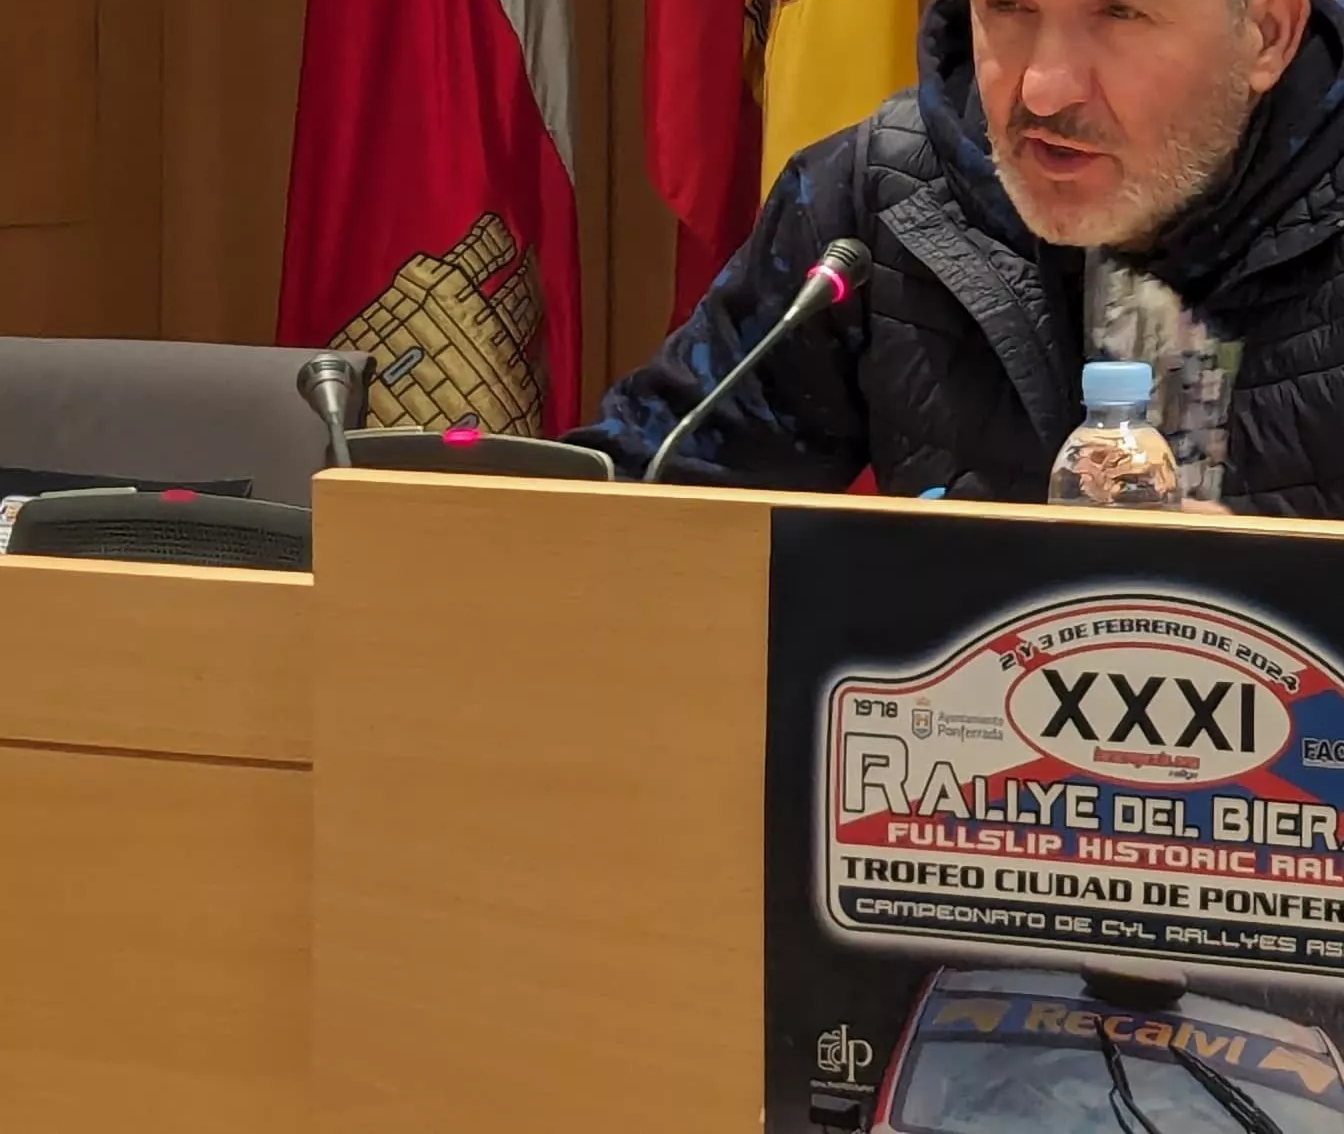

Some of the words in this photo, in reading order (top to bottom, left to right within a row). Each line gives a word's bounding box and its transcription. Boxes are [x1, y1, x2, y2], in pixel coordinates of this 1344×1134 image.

[1059, 624, 1089, 644] DE
[1092, 617, 1197, 641] FEBRERO
[1202, 630, 1232, 652] DE
[1235, 644, 1300, 692] 2024
[853, 698, 899, 718] 1978
[1040, 667, 1256, 754] XXXI
[842, 730, 1101, 831] RALLYE
[1112, 792, 1201, 841] DEL
[886, 821, 1063, 857] FULLSLIP
[1077, 835, 1258, 874] HISTORIC
[840, 855, 985, 889] TROFEO
[994, 868, 1133, 904] CIUDAD
[1142, 880, 1191, 909] DE
[855, 896, 1046, 930] CAMPEONATO
[1054, 914, 1093, 934] DE
[1101, 918, 1157, 941] CYL
[1164, 925, 1298, 954] RALLYES
[1023, 1002, 1244, 1064] Recalvi
